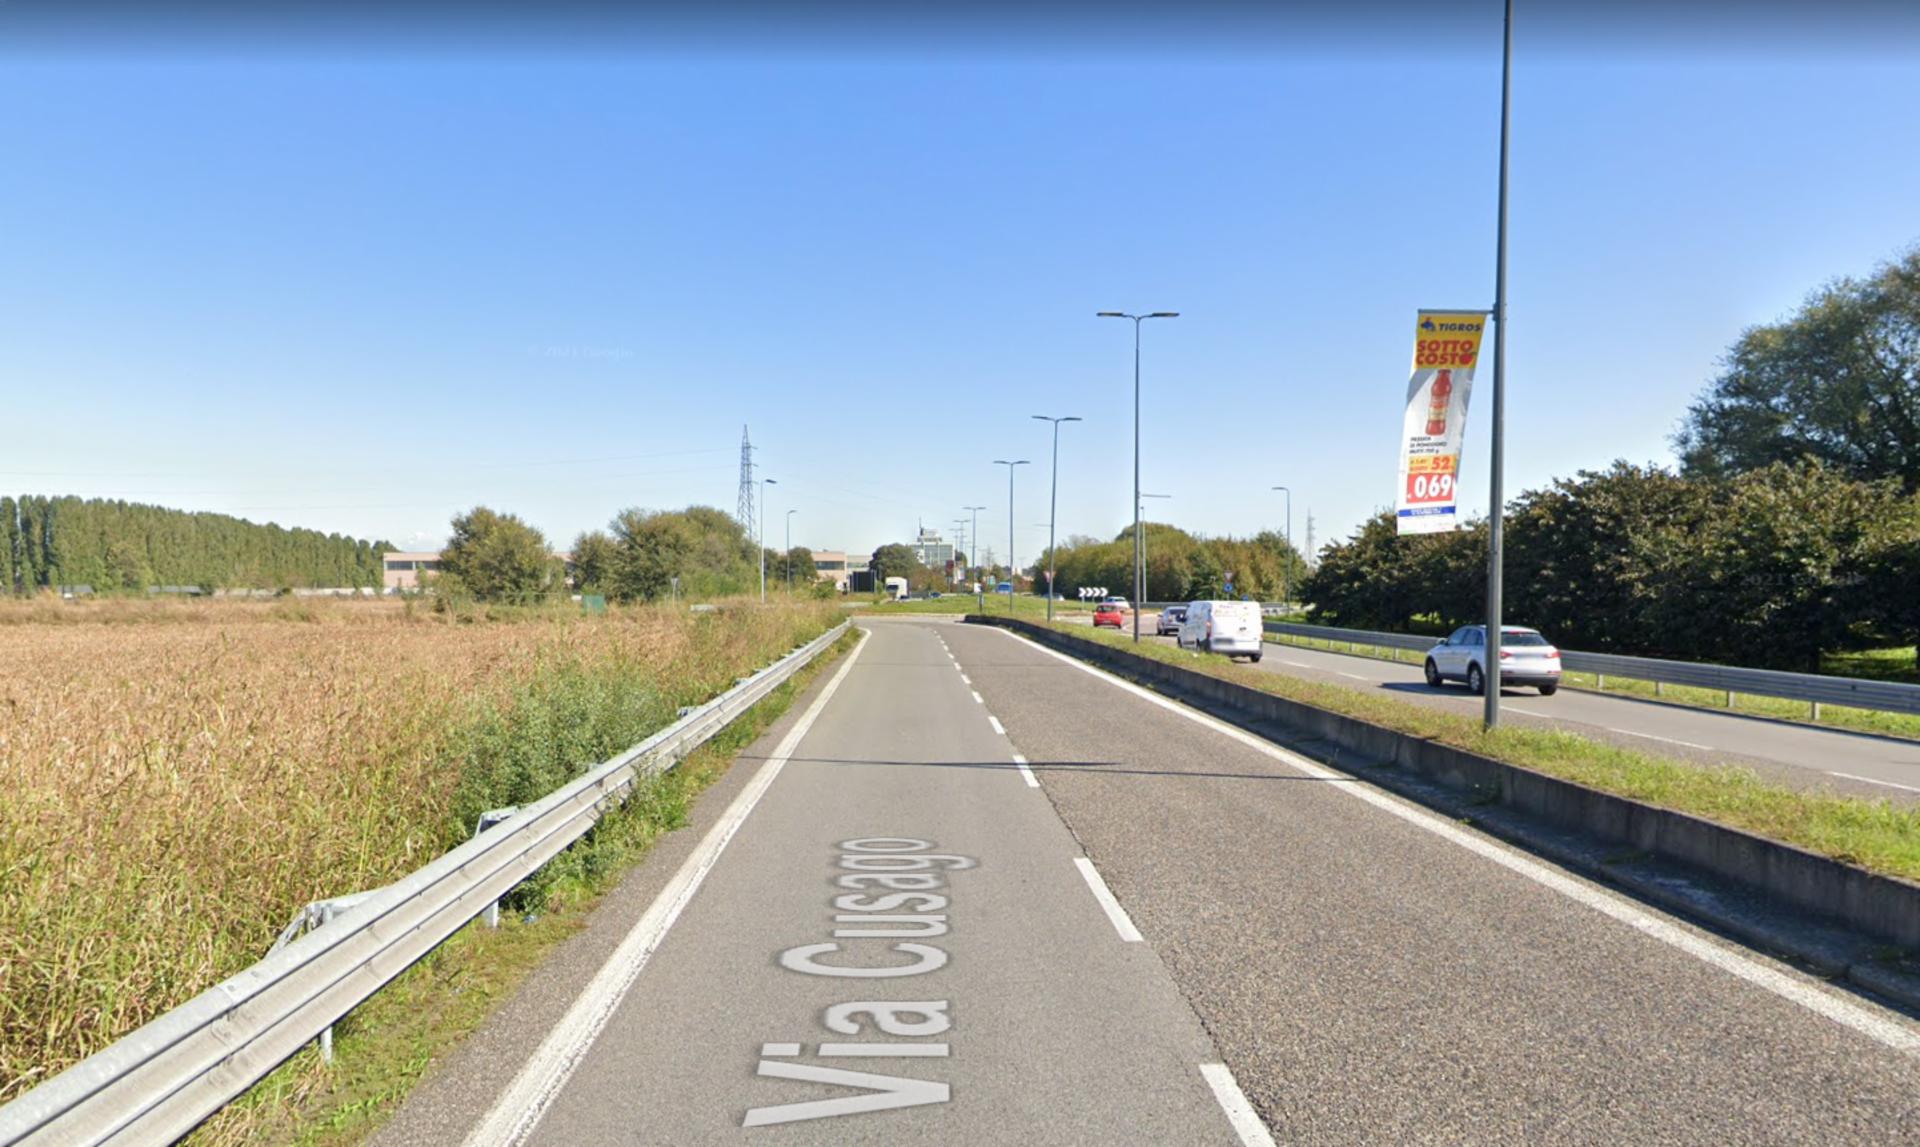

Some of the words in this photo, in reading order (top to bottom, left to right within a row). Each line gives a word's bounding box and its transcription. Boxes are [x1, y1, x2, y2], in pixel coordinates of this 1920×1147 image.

[1439, 323, 1481, 332] TIGROS
[1417, 340, 1474, 352] SOTTO
[1416, 352, 1474, 365] COSTO
